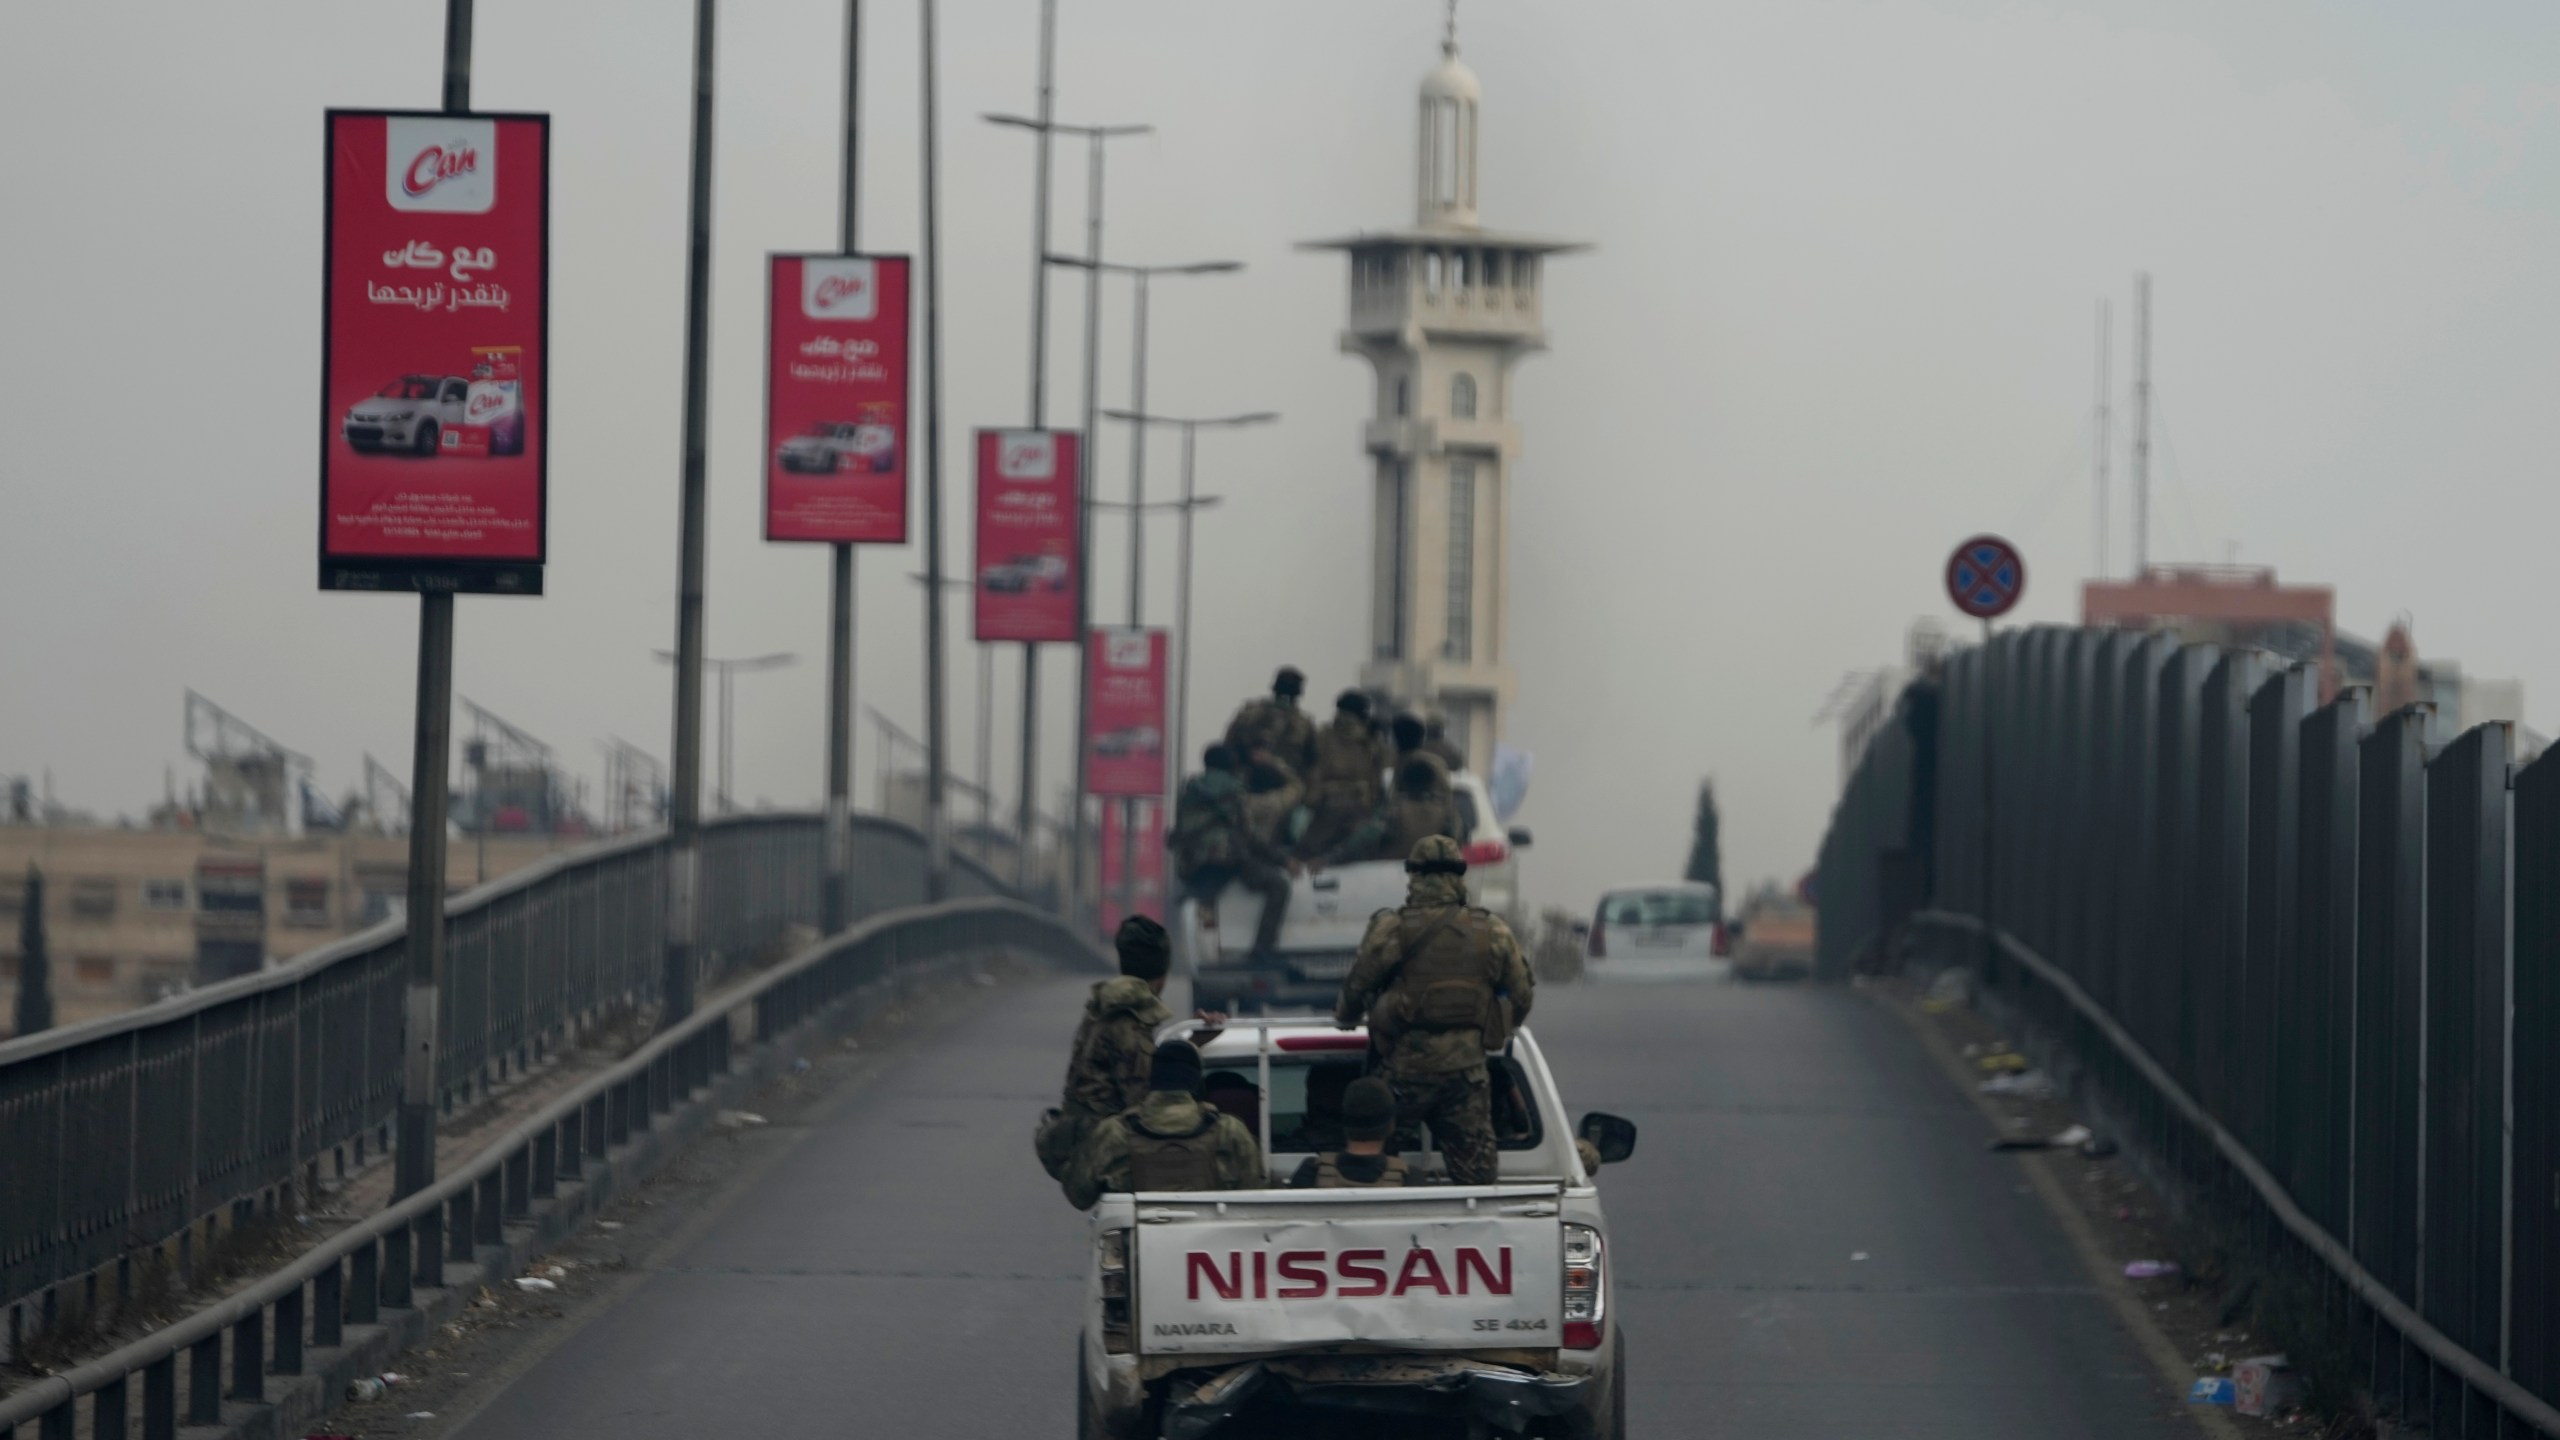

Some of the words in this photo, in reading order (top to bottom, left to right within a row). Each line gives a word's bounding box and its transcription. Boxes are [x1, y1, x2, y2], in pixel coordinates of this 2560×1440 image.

[402, 144, 477, 198] Can
[382, 239, 445, 269] كان
[449, 246, 496, 282] مع
[367, 279, 443, 312] تربحها
[446, 283, 509, 312] بتقدر
[469, 392, 505, 416] Can
[1186, 1246, 1513, 1300] NISSAN
[1152, 1322, 1239, 1337] NAVARA
[1472, 1318, 1500, 1332] SE
[1504, 1318, 1548, 1332] 4x4
